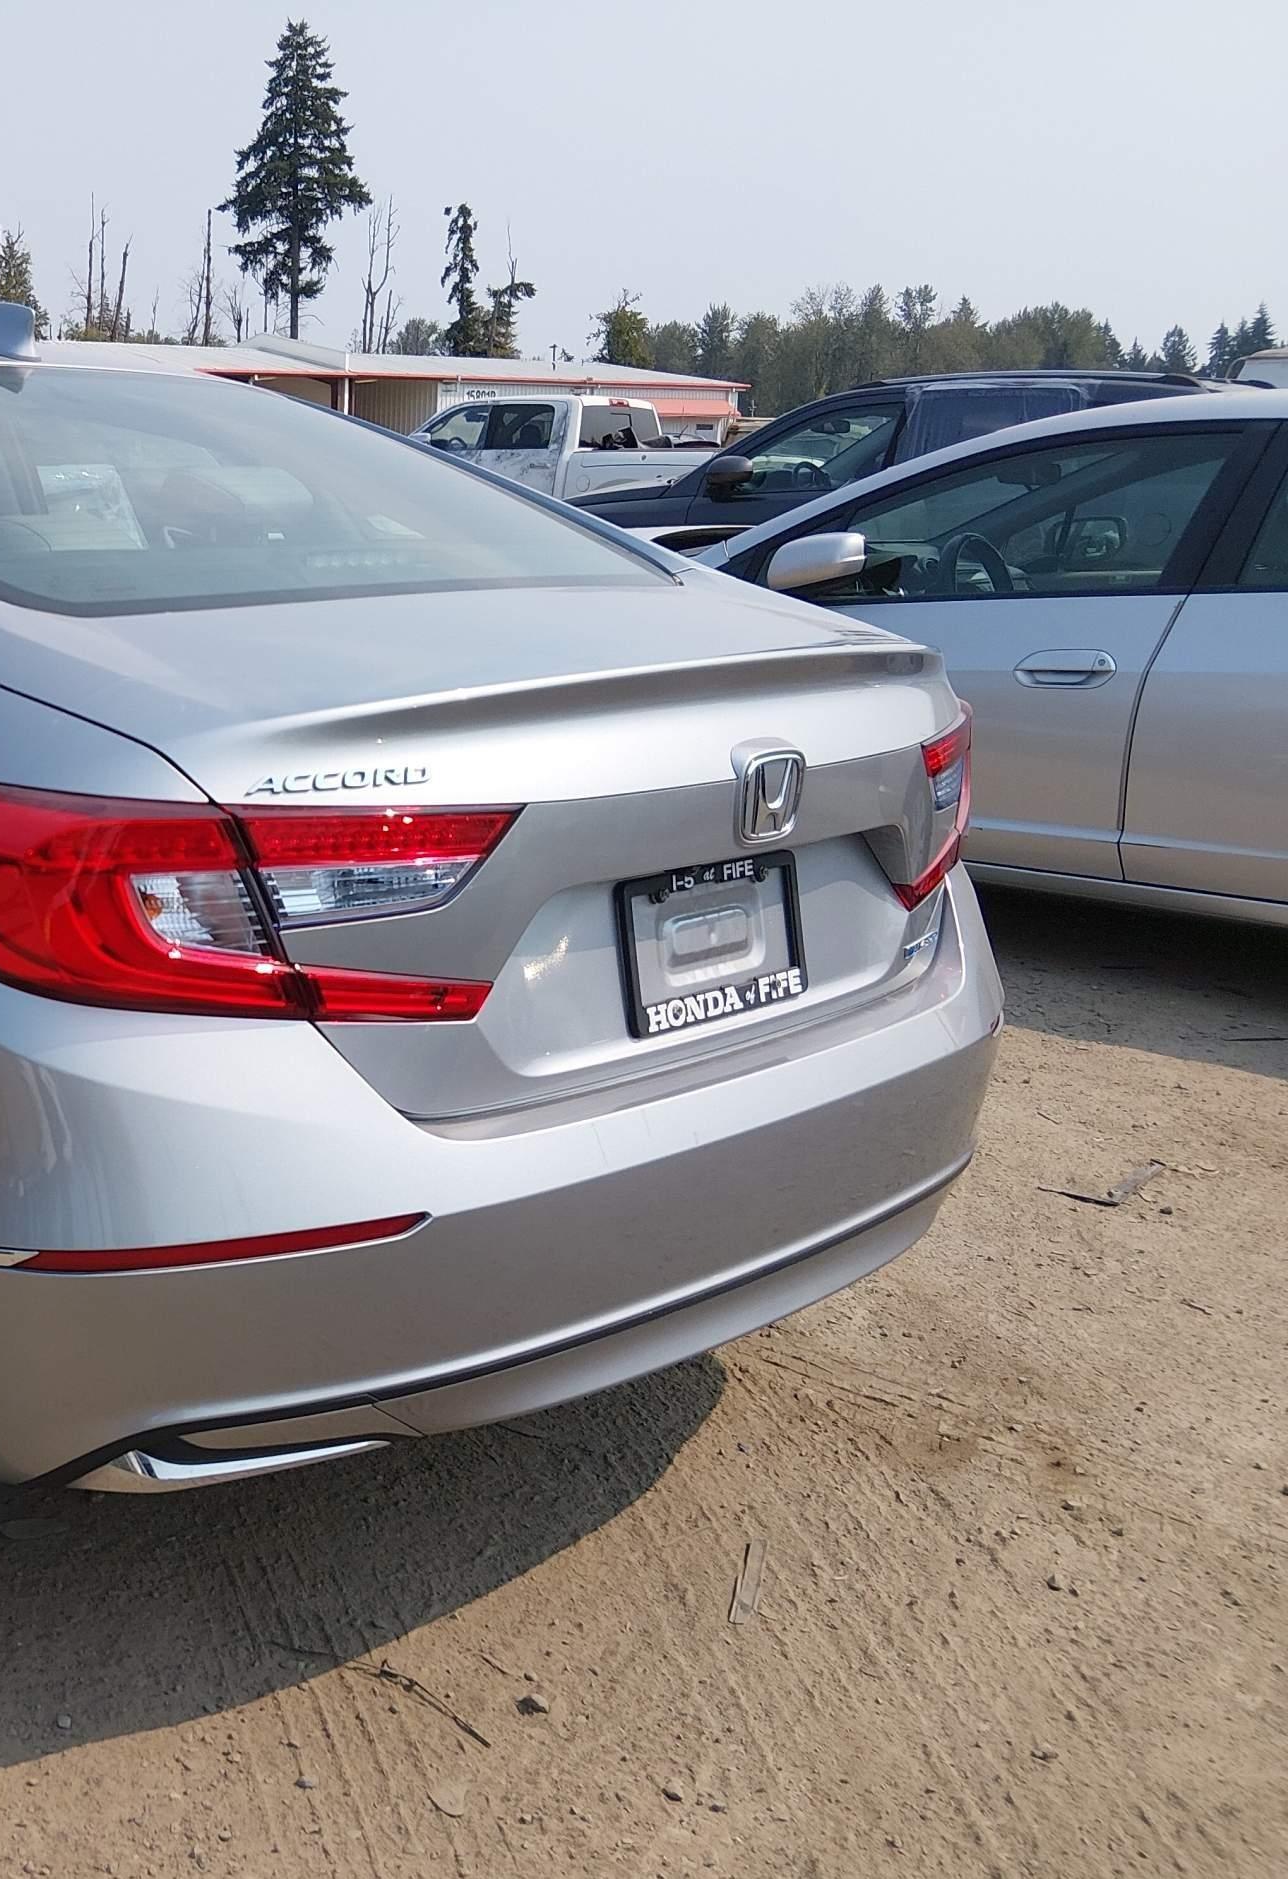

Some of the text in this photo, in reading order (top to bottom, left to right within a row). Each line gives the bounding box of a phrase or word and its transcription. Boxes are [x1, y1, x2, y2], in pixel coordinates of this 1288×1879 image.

[243, 766, 432, 798] ACCORD
[672, 874, 695, 892] I-5
[723, 859, 754, 881] FIFE
[646, 968, 803, 1033] HONDA of FIFE
